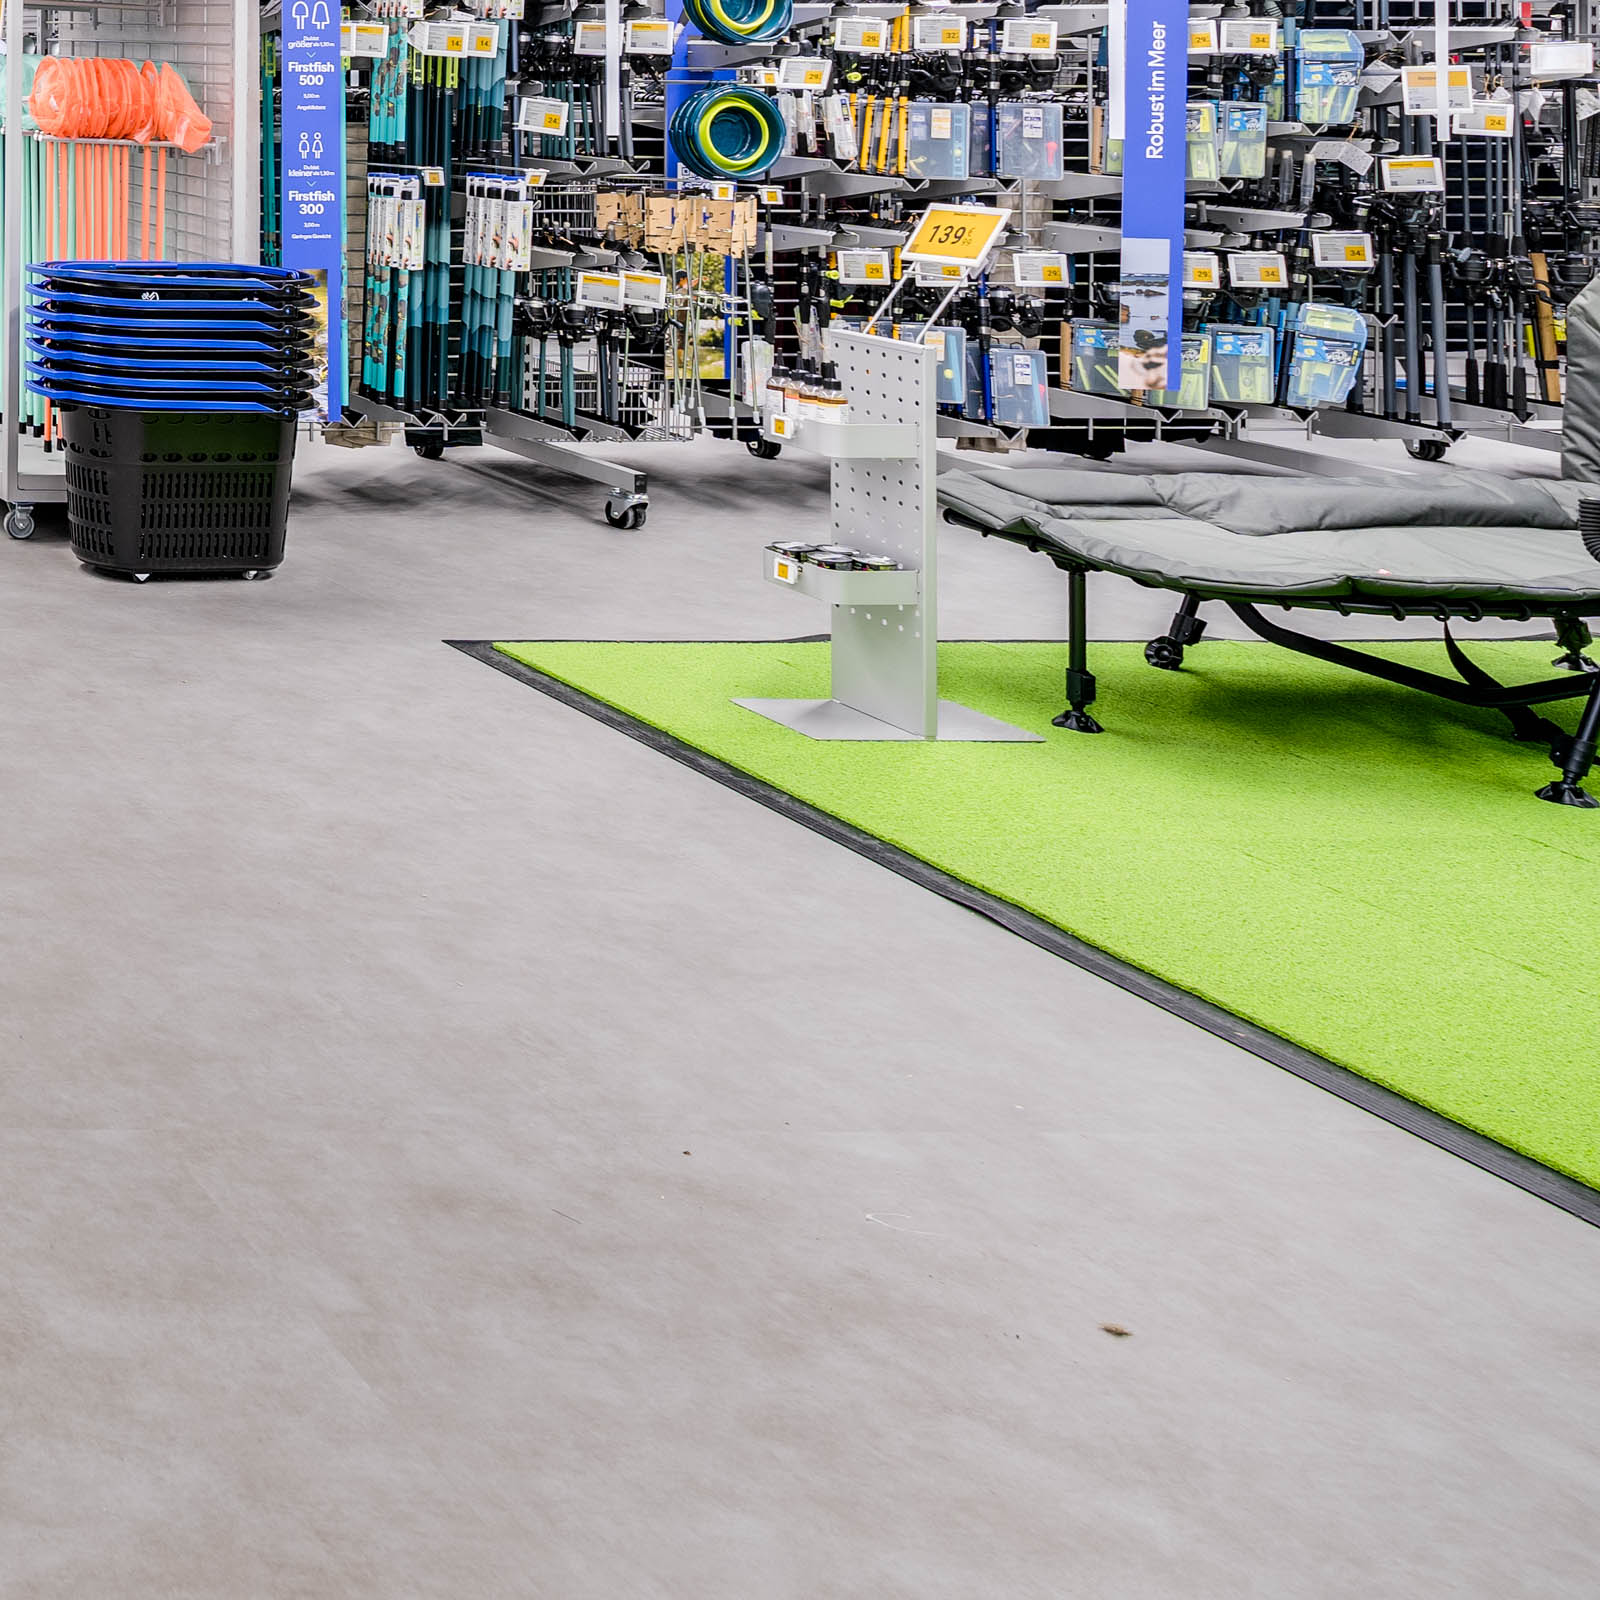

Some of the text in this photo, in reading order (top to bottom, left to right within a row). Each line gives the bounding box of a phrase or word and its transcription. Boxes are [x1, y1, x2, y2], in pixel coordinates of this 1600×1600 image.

[288, 61, 334, 73] Firstfish
[298, 75, 324, 86] 500
[1146, 21, 1167, 159] Robust im Meer
[288, 190, 335, 202] Firstfish
[298, 203, 324, 215] 300
[928, 225, 967, 244] 139
